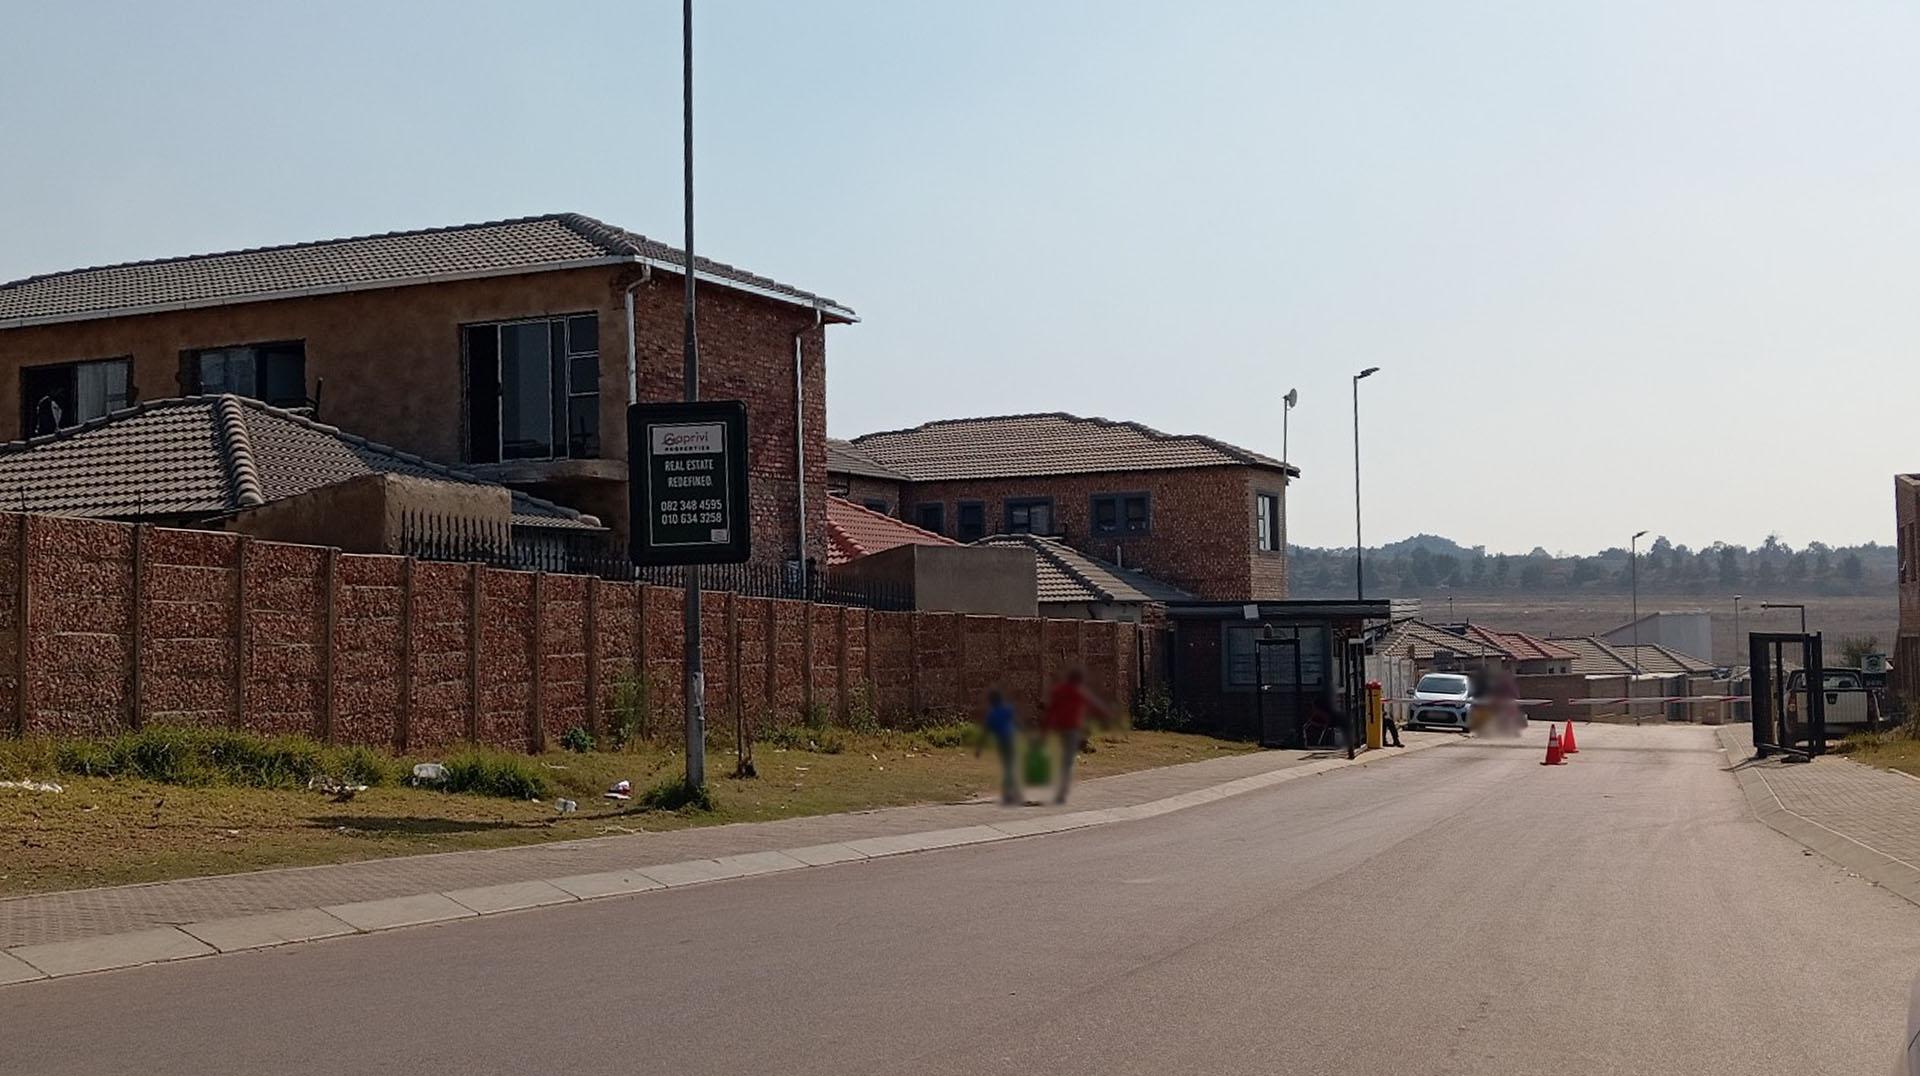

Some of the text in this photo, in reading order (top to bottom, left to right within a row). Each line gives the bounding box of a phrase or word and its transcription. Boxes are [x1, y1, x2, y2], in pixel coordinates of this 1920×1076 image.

[664, 459, 714, 471] REAL ESTATE
[661, 498, 722, 512] 082 348 4595
[661, 512, 722, 525] 010 634 3258
